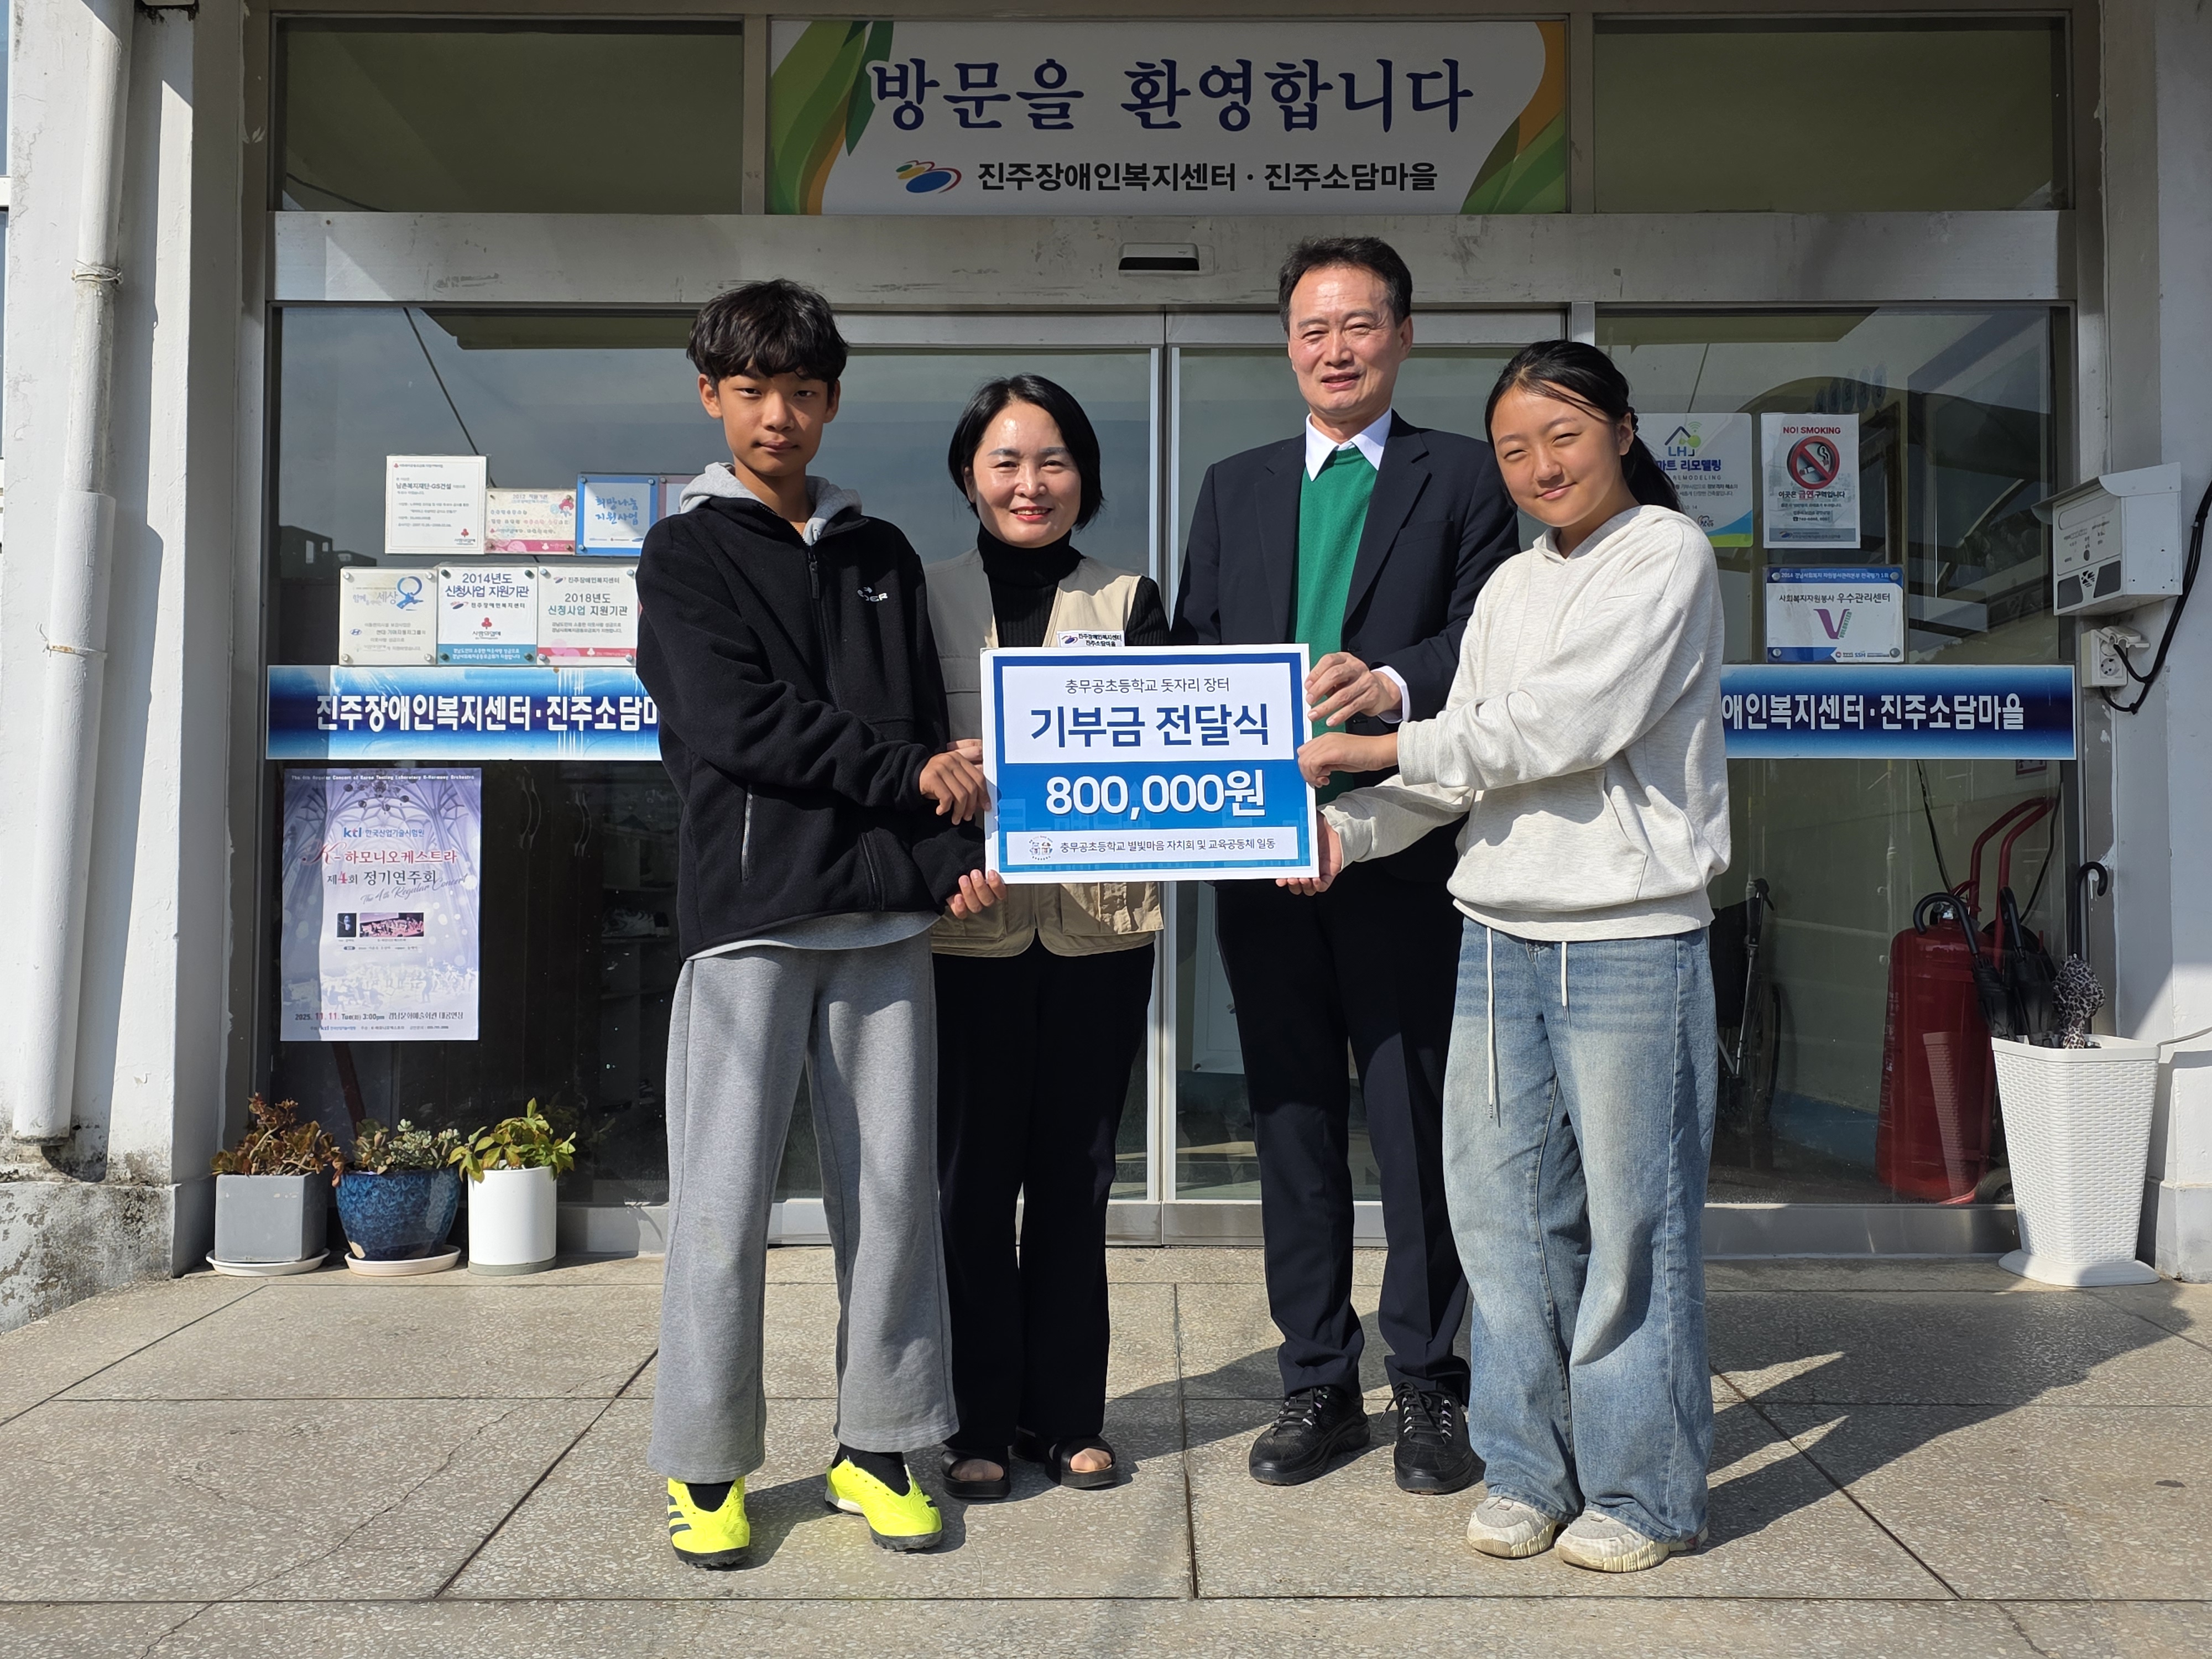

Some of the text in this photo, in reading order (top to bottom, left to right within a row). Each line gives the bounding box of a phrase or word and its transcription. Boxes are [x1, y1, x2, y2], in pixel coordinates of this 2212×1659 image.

[873, 57, 1475, 133] 방문을 환영합니다
[977, 162, 1235, 192] 진주장애인복지센터
[1265, 162, 1438, 192] 진주소담마을
[1656, 460, 1721, 471] 마트 리모델링
[595, 496, 638, 510] 희망나눔
[595, 512, 639, 526] 지원사업
[462, 573, 513, 585] 2014년도
[376, 591, 398, 604] 세상
[445, 585, 529, 597] 신청사업 지원기관
[565, 593, 611, 603] 2018년도
[1837, 593, 1890, 603] 우수관리센터
[548, 606, 628, 616] 신청사업 지원기관
[1065, 677, 1230, 694] 충무공초등학교 돗자리 장터
[1030, 703, 1269, 748] 기부금 전달식
[1046, 769, 1266, 820] 800,000원
[1060, 838, 1276, 853] 충무공초등학교 별빛마음 자치회 및 교육공동체 일동
[327, 870, 436, 885] 제4회 정기연주회
[392, 885, 430, 900] Regular
[432, 873, 468, 891] Concert
